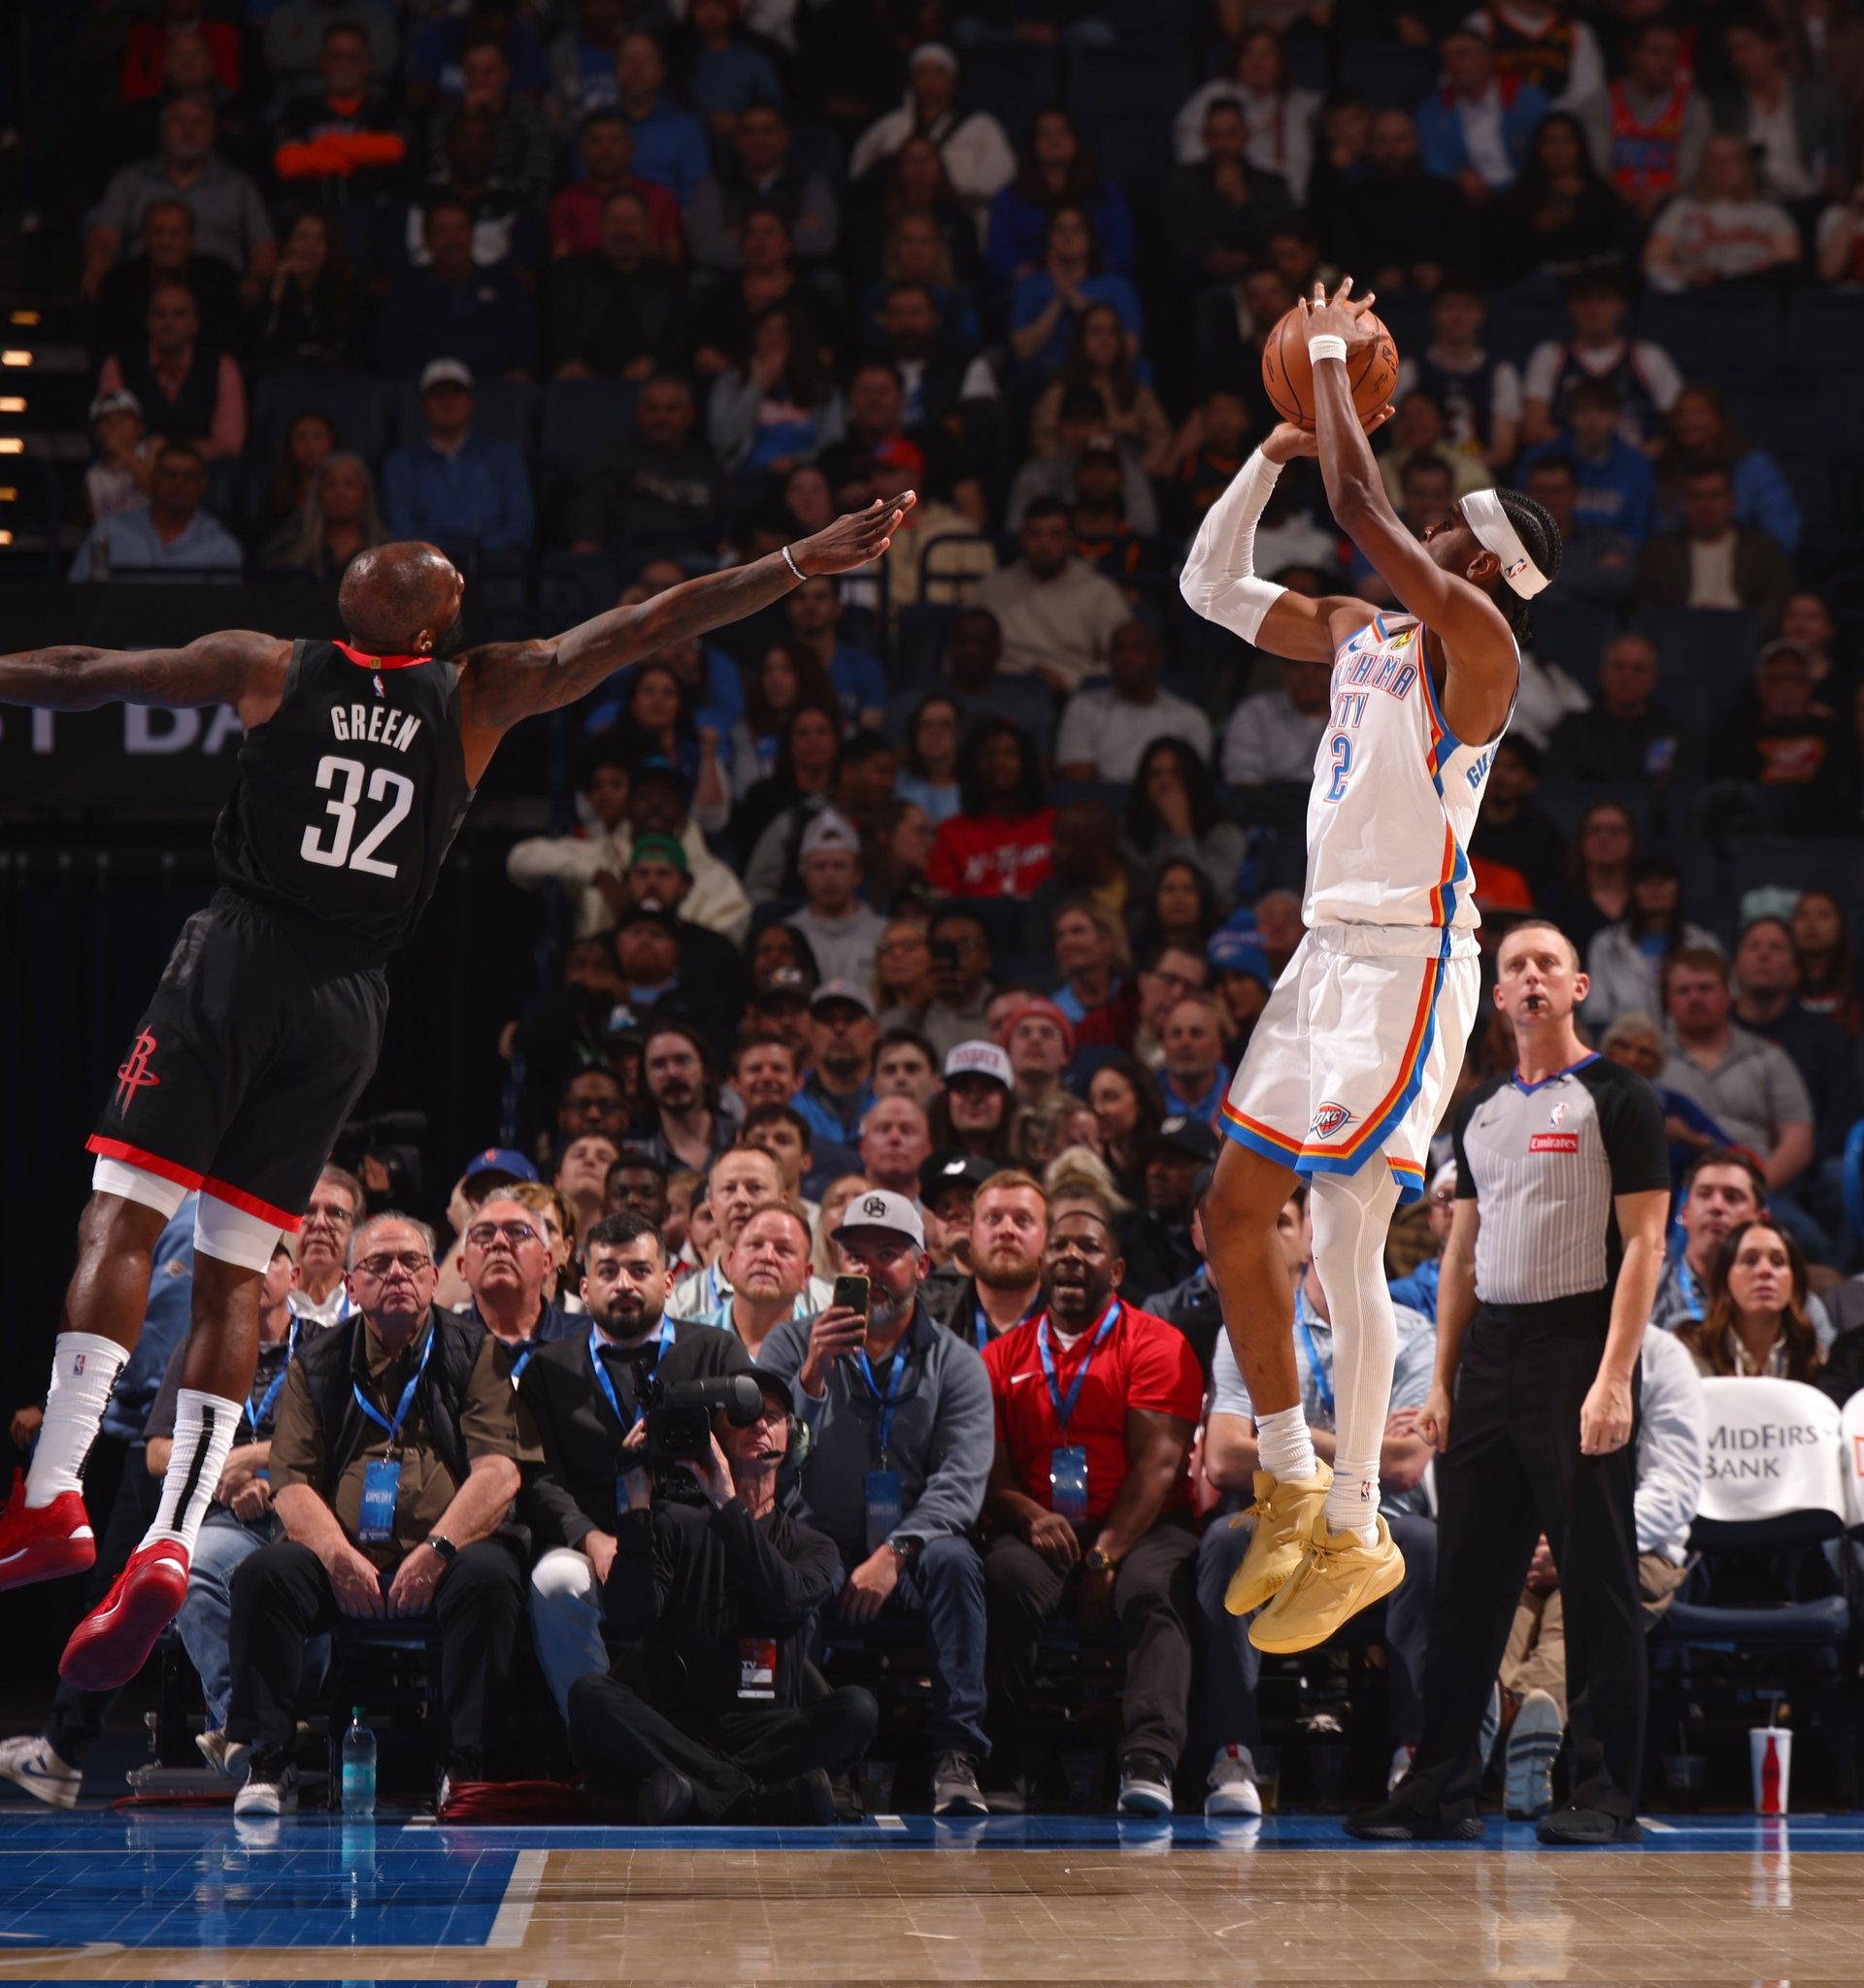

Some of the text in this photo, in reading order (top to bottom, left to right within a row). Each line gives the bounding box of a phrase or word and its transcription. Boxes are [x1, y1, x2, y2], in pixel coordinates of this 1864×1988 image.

[331, 704, 422, 753] GREEN
[1323, 732, 1353, 804] 2
[300, 755, 416, 879] 32
[1530, 1136, 1577, 1150] Emirates
[741, 1660, 757, 1670] TV
